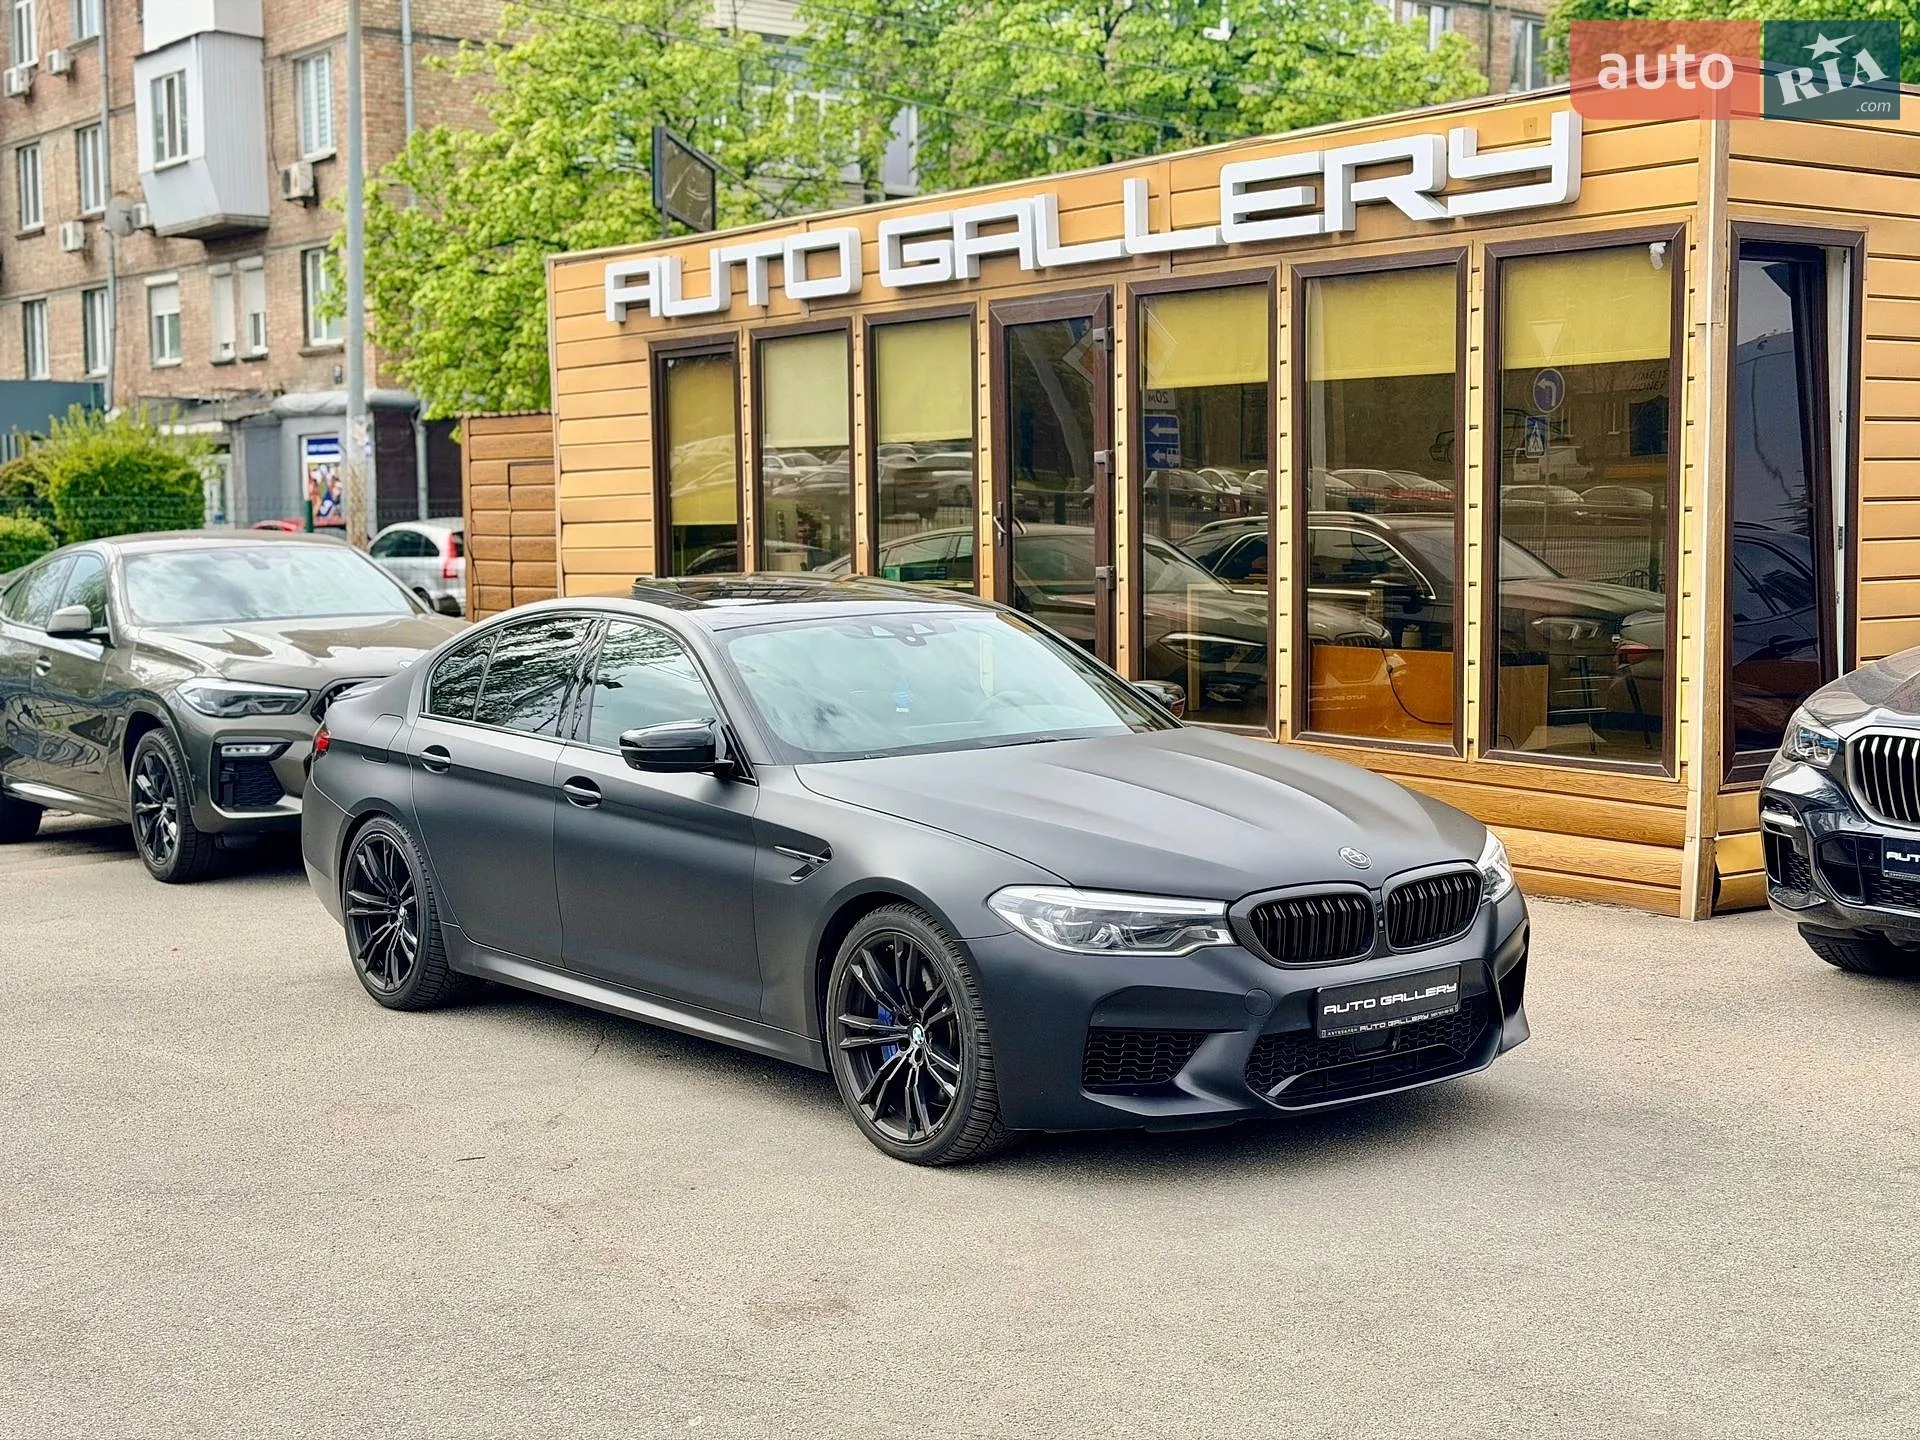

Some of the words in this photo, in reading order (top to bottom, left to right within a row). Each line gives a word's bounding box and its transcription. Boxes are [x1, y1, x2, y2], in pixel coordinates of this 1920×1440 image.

[605, 227, 862, 323] AUTO
[879, 110, 1583, 288] GALLERY
[1323, 998, 1376, 1015] AUTO
[1380, 982, 1457, 1006] GALLERY
[1359, 1022, 1386, 1032] AUTO
[1387, 1014, 1430, 1027] GALLERY
